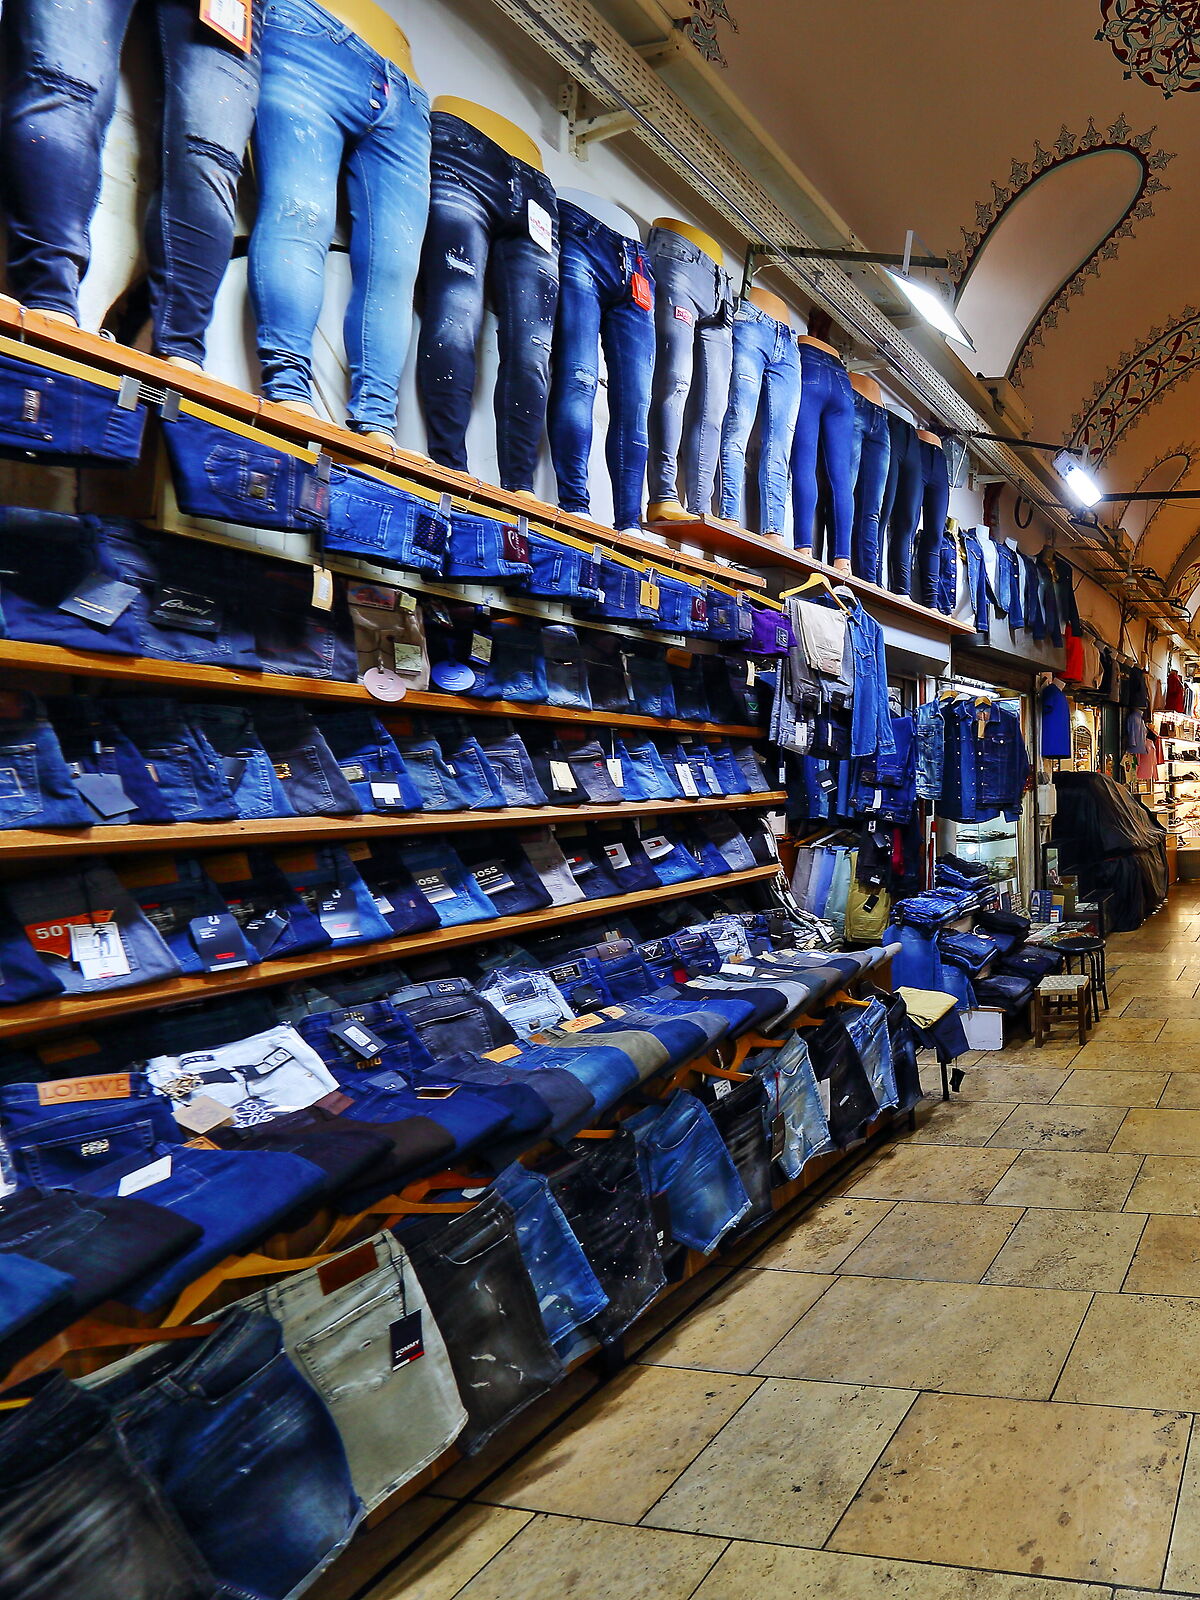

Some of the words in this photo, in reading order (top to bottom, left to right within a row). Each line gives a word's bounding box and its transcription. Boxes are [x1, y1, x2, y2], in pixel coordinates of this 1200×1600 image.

[416, 875, 440, 886] OSS
[42, 1078, 128, 1099] LOEWE
[395, 1339, 420, 1355] TOMMY
